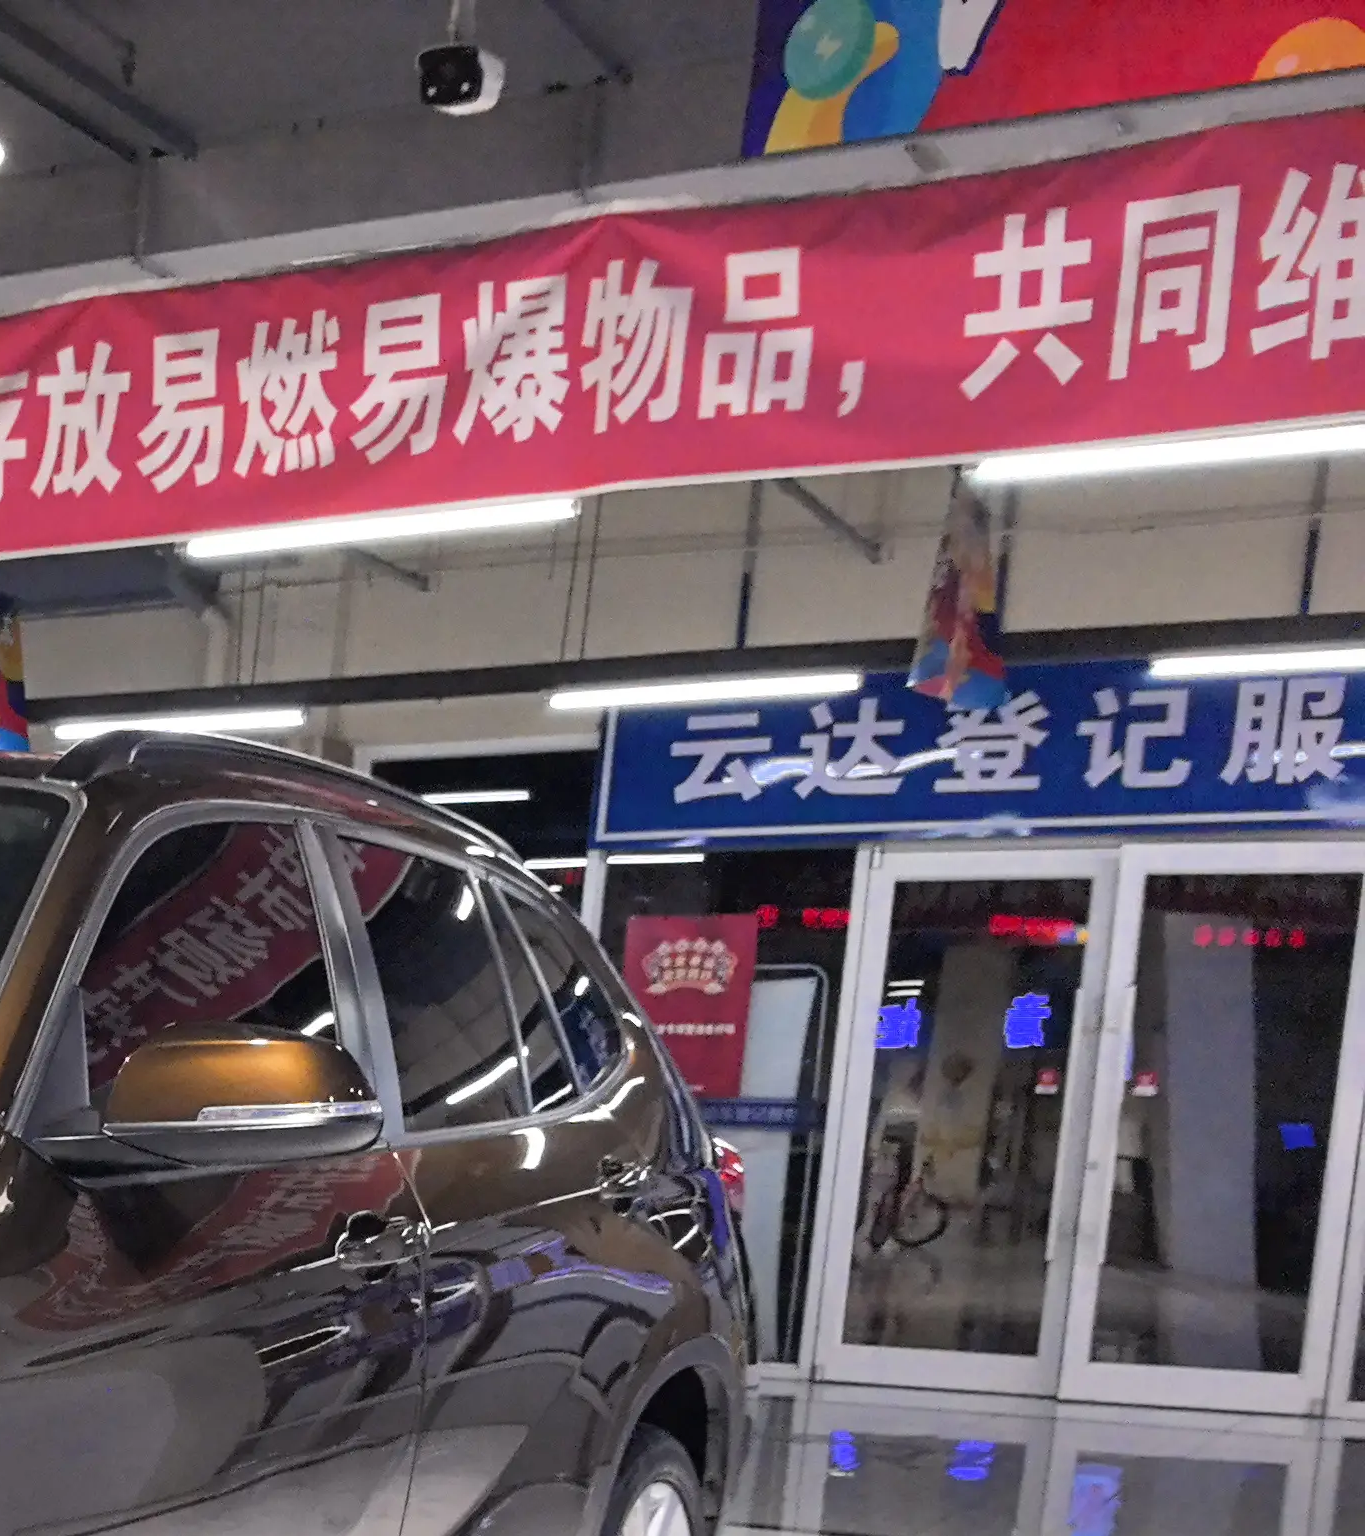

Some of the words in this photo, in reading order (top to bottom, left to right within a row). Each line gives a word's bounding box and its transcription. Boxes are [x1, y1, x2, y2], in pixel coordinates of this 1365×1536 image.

[669, 674, 1349, 804] 云达登记服
